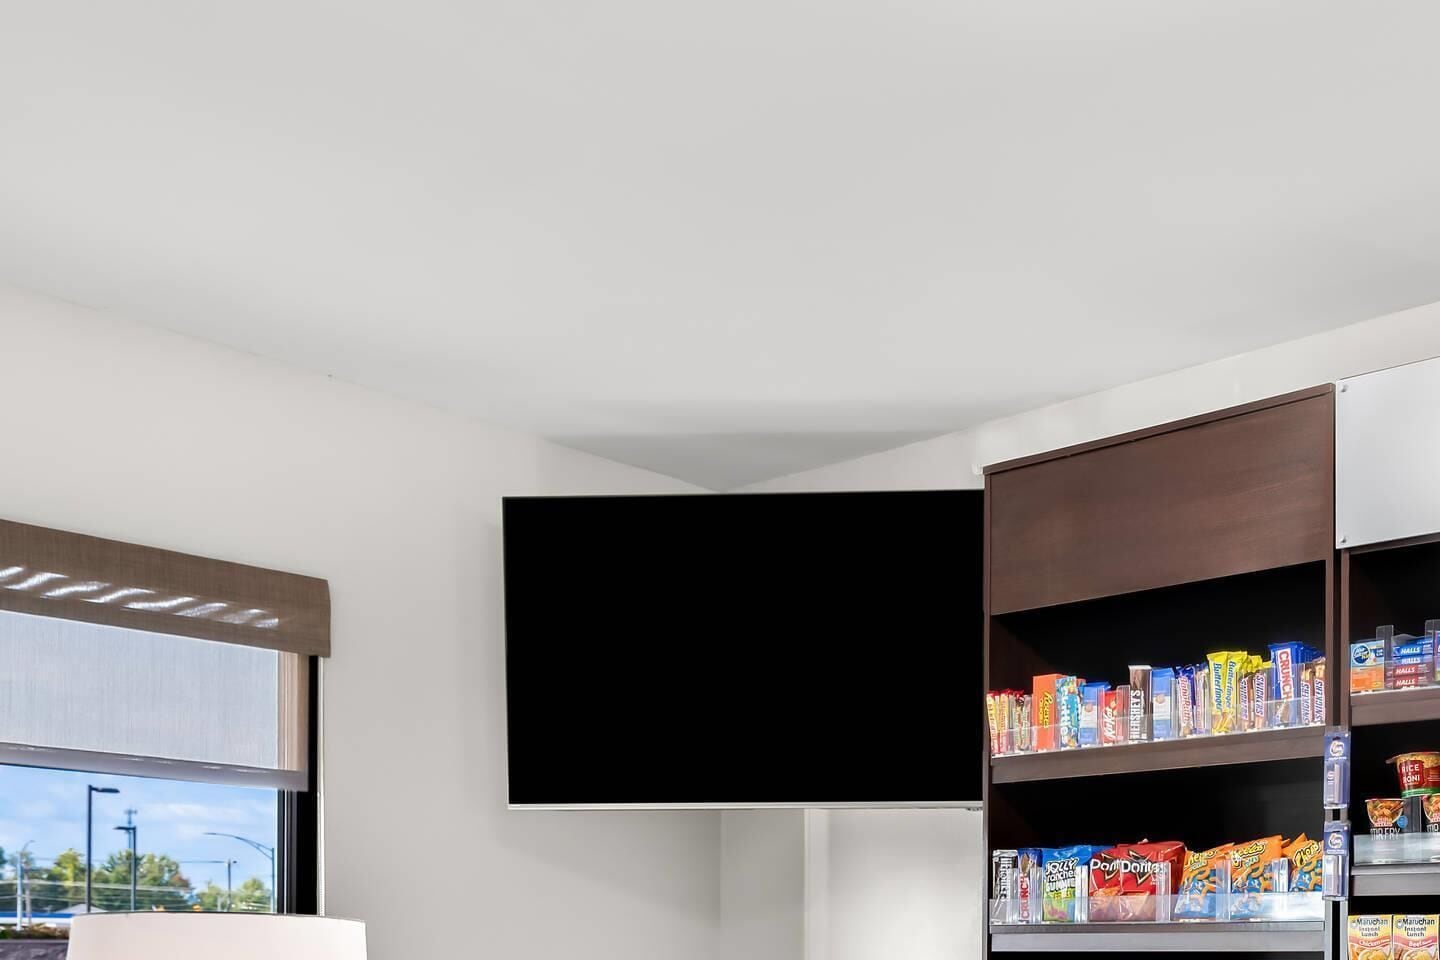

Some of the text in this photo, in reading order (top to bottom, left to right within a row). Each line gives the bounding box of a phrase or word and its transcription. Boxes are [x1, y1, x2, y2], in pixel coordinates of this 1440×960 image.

[1401, 646, 1420, 654] HALLS
[1213, 662, 1223, 713] Butterfinger
[1255, 673, 1264, 716] SNICKERS
[1279, 650, 1293, 700] CRUNCH
[1396, 678, 1415, 686] HALLS
[1301, 683, 1310, 726] SNICKERS
[1315, 679, 1325, 724] SNICKERS
[1402, 764, 1419, 772] RICE
[1046, 858, 1077, 875] JOLLY
